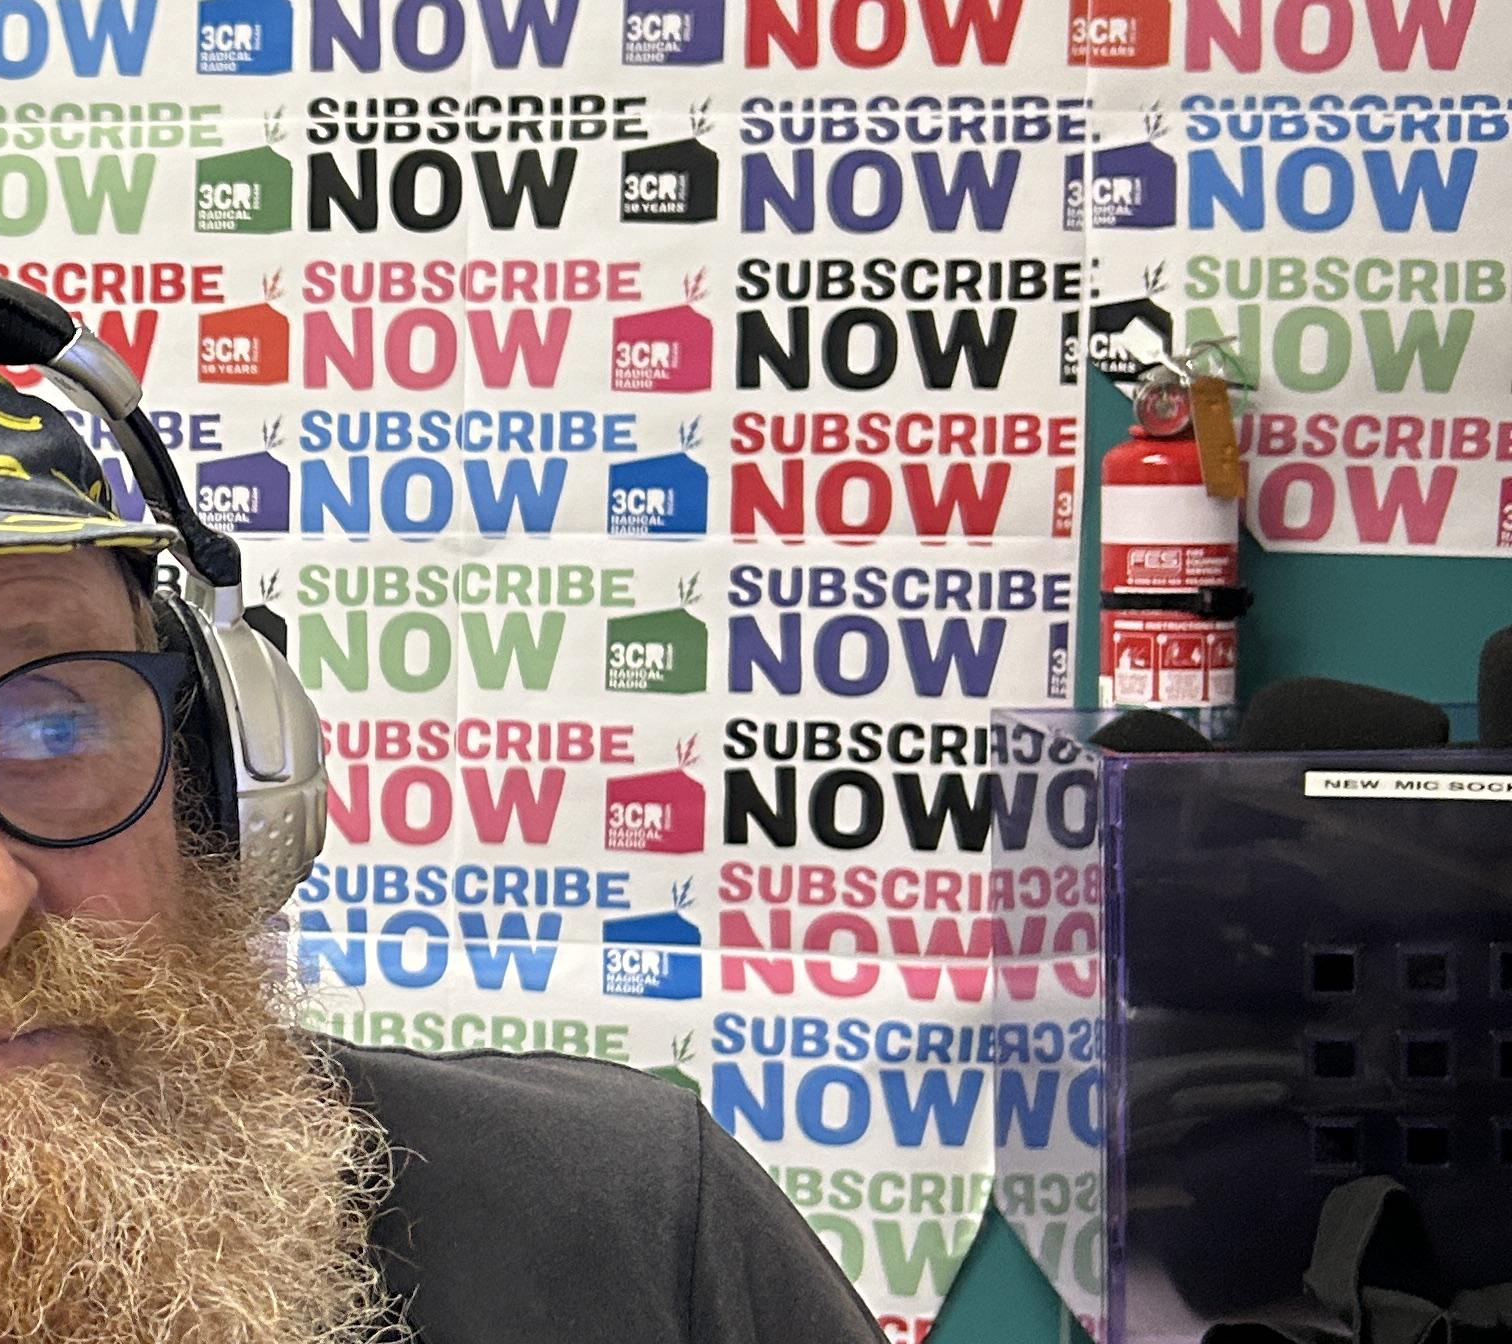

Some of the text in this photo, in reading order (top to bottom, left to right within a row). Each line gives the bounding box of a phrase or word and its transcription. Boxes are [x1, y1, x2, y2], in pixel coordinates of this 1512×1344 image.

[201, 23, 252, 52] 3CR
[626, 15, 680, 44] 3CR
[307, 95, 648, 144] SUBSCRIBE
[199, 183, 251, 212] 3CR
[308, 147, 577, 233] NOW
[624, 174, 676, 201] 3CR
[741, 148, 1021, 234] NOW
[1188, 145, 1478, 233] NOW
[198, 210, 251, 221] RADICAL
[198, 221, 237, 230] RADIO
[303, 259, 642, 304] SUBSCRIBE
[736, 258, 1099, 302] SUBSCRIBE
[202, 338, 252, 362] 3CR
[303, 307, 572, 391] NOW
[616, 341, 670, 369] 3CR
[736, 306, 1017, 391] NOW
[614, 368, 670, 380] RADICAL
[614, 379, 652, 388] RADIO
[300, 410, 637, 453] SUBSCRIBE
[731, 412, 1077, 457] SUBSCRIBE
[612, 488, 664, 515] 3CR
[297, 563, 635, 608] SUBSCRIBE
[728, 565, 1071, 612] SUBSCRIBE
[298, 609, 567, 694] NOW
[610, 642, 664, 669] 3CR
[728, 612, 1007, 698] NOW
[1324, 778, 1380, 790] NEW
[1395, 779, 1439, 791] MIC
[609, 803, 662, 828] 3CR
[723, 767, 991, 852] NOW
[299, 865, 631, 909] SUBSCRIBE
